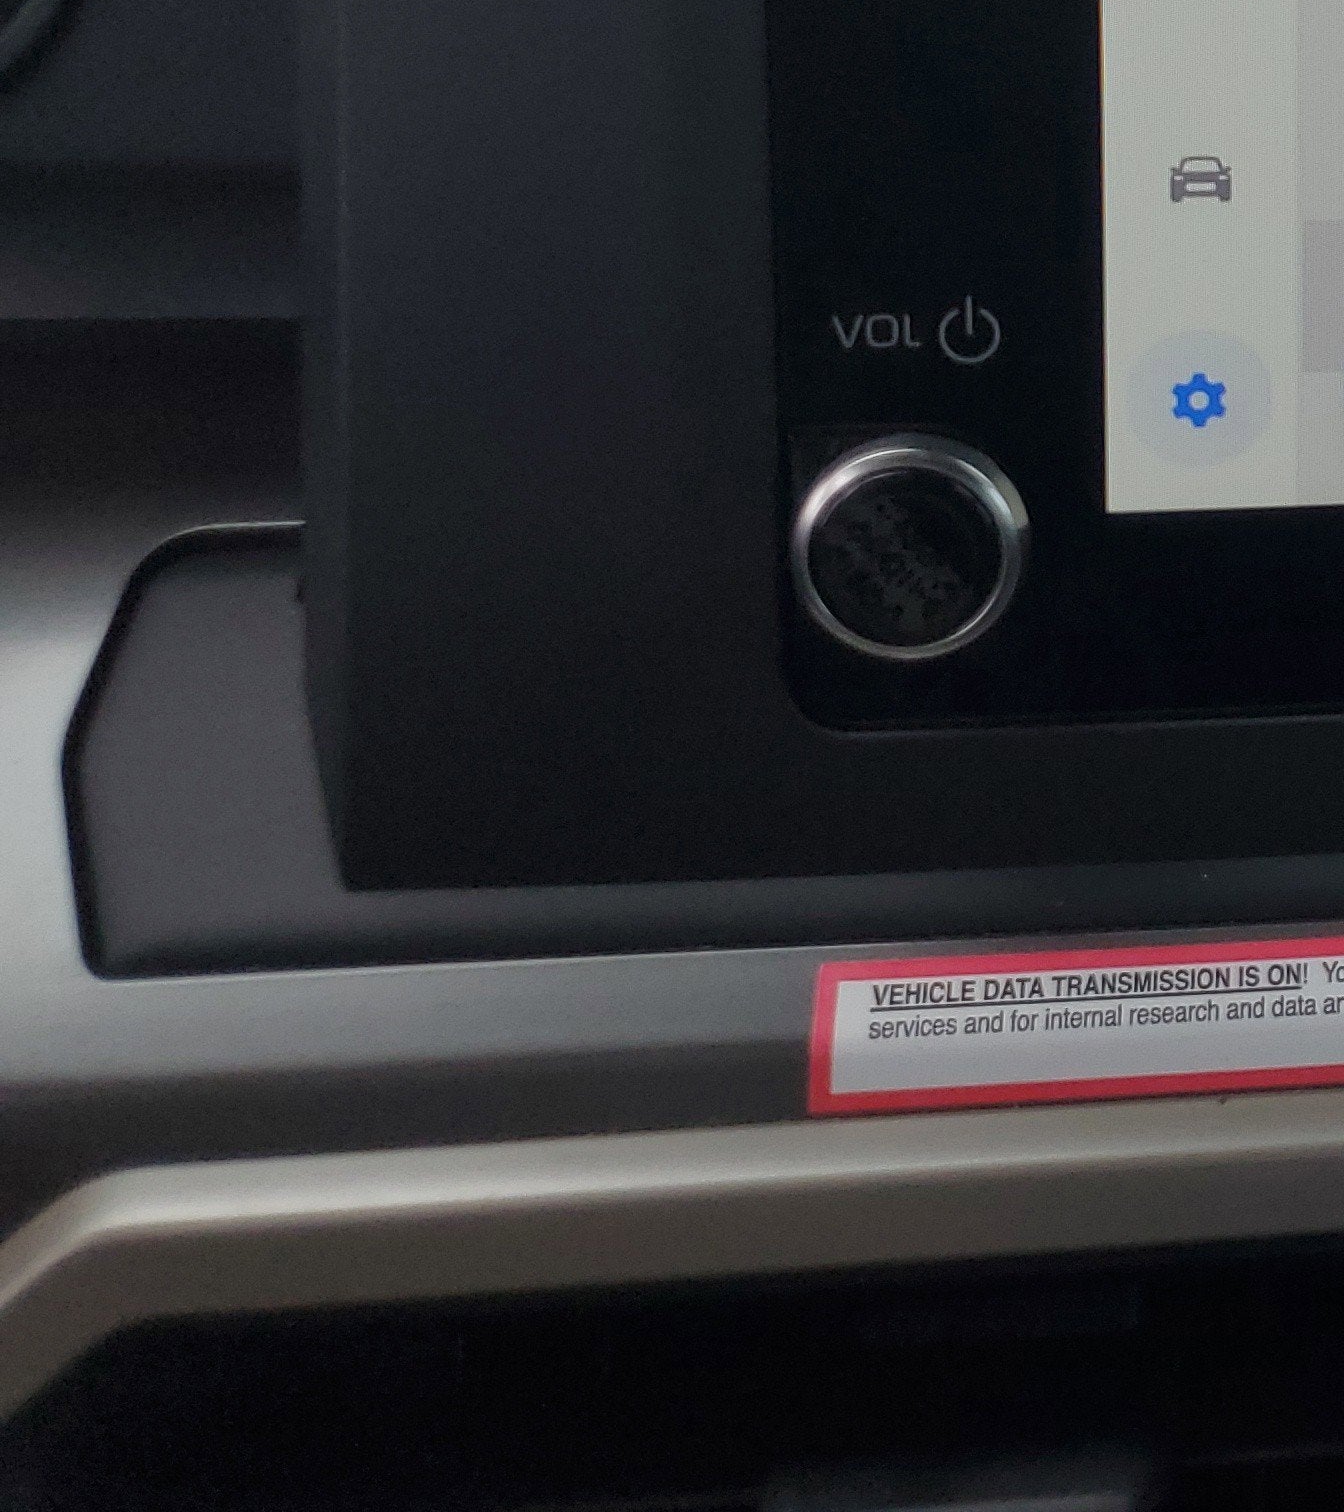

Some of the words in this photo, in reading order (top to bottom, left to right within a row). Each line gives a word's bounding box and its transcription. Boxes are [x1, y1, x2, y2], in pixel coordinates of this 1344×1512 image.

[832, 314, 920, 348] VOL
[872, 980, 975, 1006] VEHICLE
[984, 976, 1045, 1001] DATA
[1052, 966, 1231, 997] TRANSMISSION
[1239, 964, 1259, 986] IS
[1267, 963, 1308, 987] ON!
[869, 1015, 957, 1039] services
[964, 1011, 1003, 1034] and
[1010, 1008, 1039, 1032] for
[1045, 1004, 1123, 1030] internal
[1129, 998, 1220, 1025] research
[1226, 996, 1264, 1019] and
[1271, 991, 1317, 1018] data
